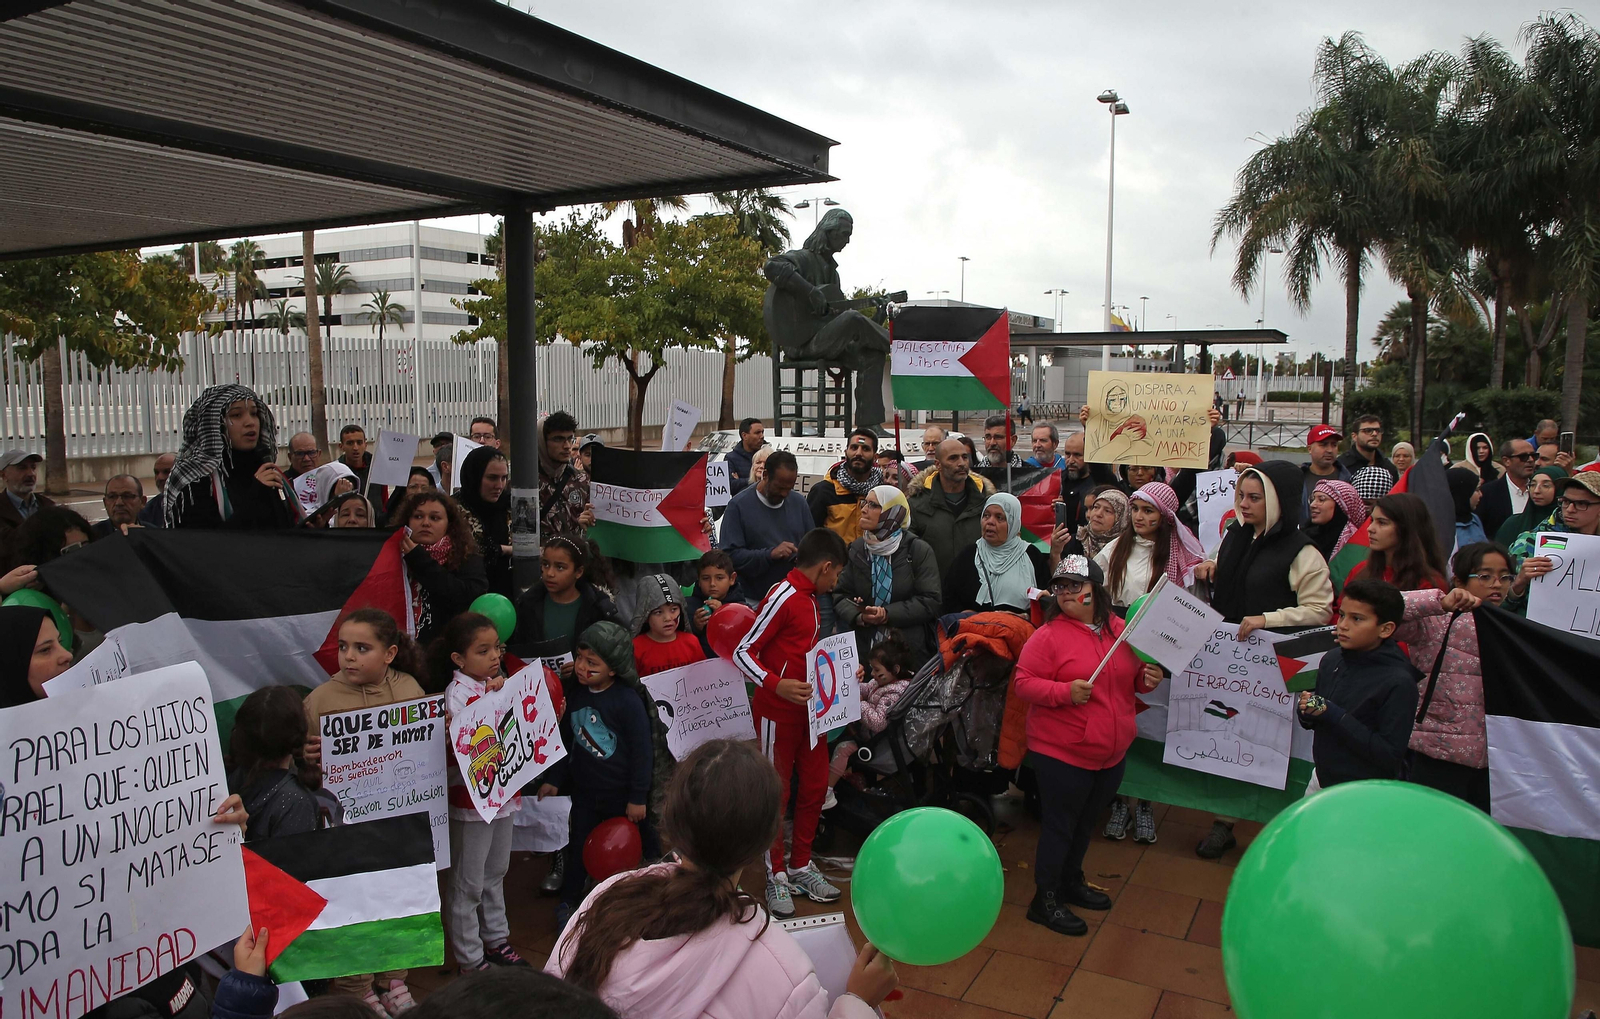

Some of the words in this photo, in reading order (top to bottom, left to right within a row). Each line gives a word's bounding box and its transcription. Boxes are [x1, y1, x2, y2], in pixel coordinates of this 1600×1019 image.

[1134, 383, 1183, 396] DISPARA
[1186, 385, 1197, 395] A
[1131, 400, 1147, 412] UN
[1148, 397, 1177, 412] NIÑO
[1181, 400, 1188, 412] Y
[1149, 413, 1207, 426] MATARÁS
[1155, 427, 1162, 436] A
[1166, 428, 1185, 438] UNA
[775, 441, 791, 452] LA
[797, 441, 847, 453] PALABR
[1155, 440, 1206, 457] MADRE
[1173, 595, 1207, 619] PALESTINA
[1160, 631, 1178, 645] LIBRE
[1227, 663, 1249, 677] es
[323, 713, 373, 738] ¿QUE
[377, 697, 446, 730] QUIERES
[9, 726, 88, 784] PARA
[93, 715, 141, 756] LOS
[143, 696, 208, 746] HIJOS
[331, 735, 360, 756] SER
[367, 733, 384, 751] DE
[392, 723, 435, 746] MAYOR?
[143, 738, 209, 793] QUIEN
[21, 836, 44, 882] A
[62, 821, 101, 867] UN
[110, 783, 219, 854] INOCENTE
[0, 886, 59, 932] MO
[74, 867, 106, 909] SI
[83, 911, 112, 950] LA
